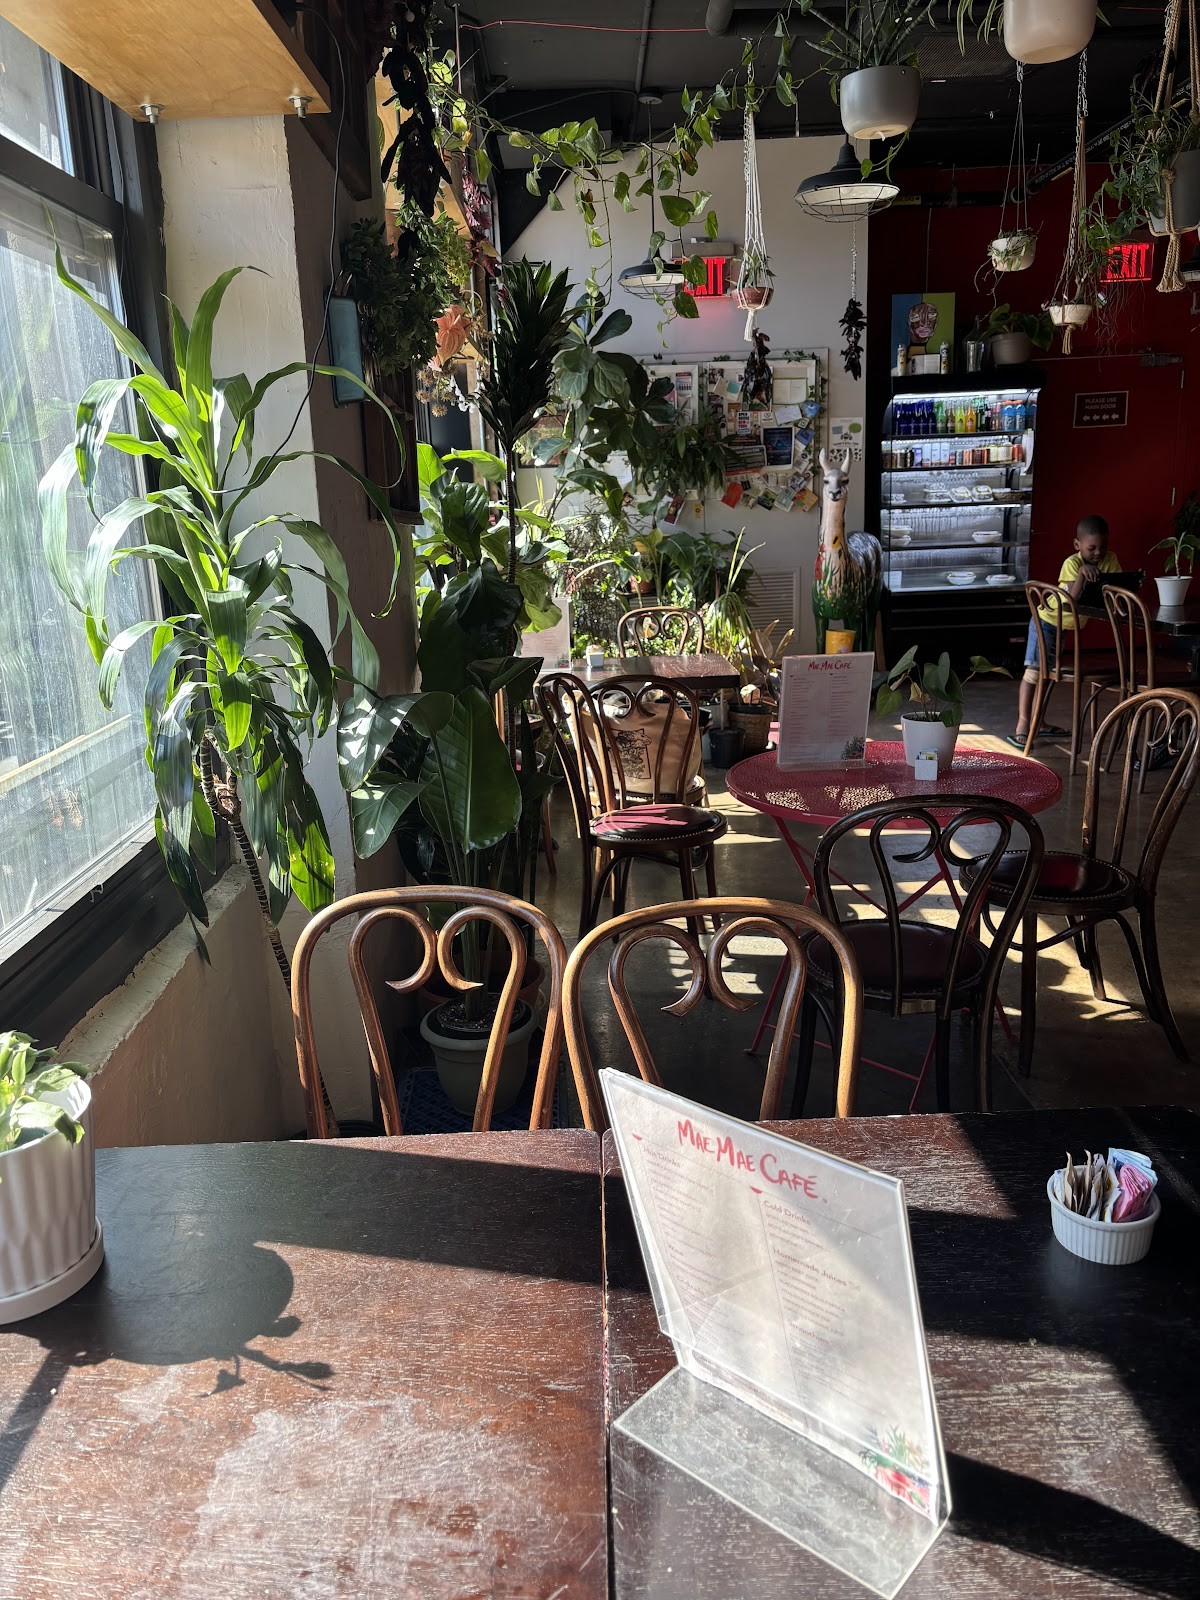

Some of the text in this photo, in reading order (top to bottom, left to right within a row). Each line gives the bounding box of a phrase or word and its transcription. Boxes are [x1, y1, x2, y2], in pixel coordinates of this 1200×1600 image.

[684, 257, 726, 295] IT
[677, 1119, 715, 1153] MAE
[716, 1136, 756, 1172] MAE
[763, 1200, 811, 1226] Cold Drinks
[773, 1247, 820, 1274] Homemade
[821, 1269, 847, 1287] Juices
